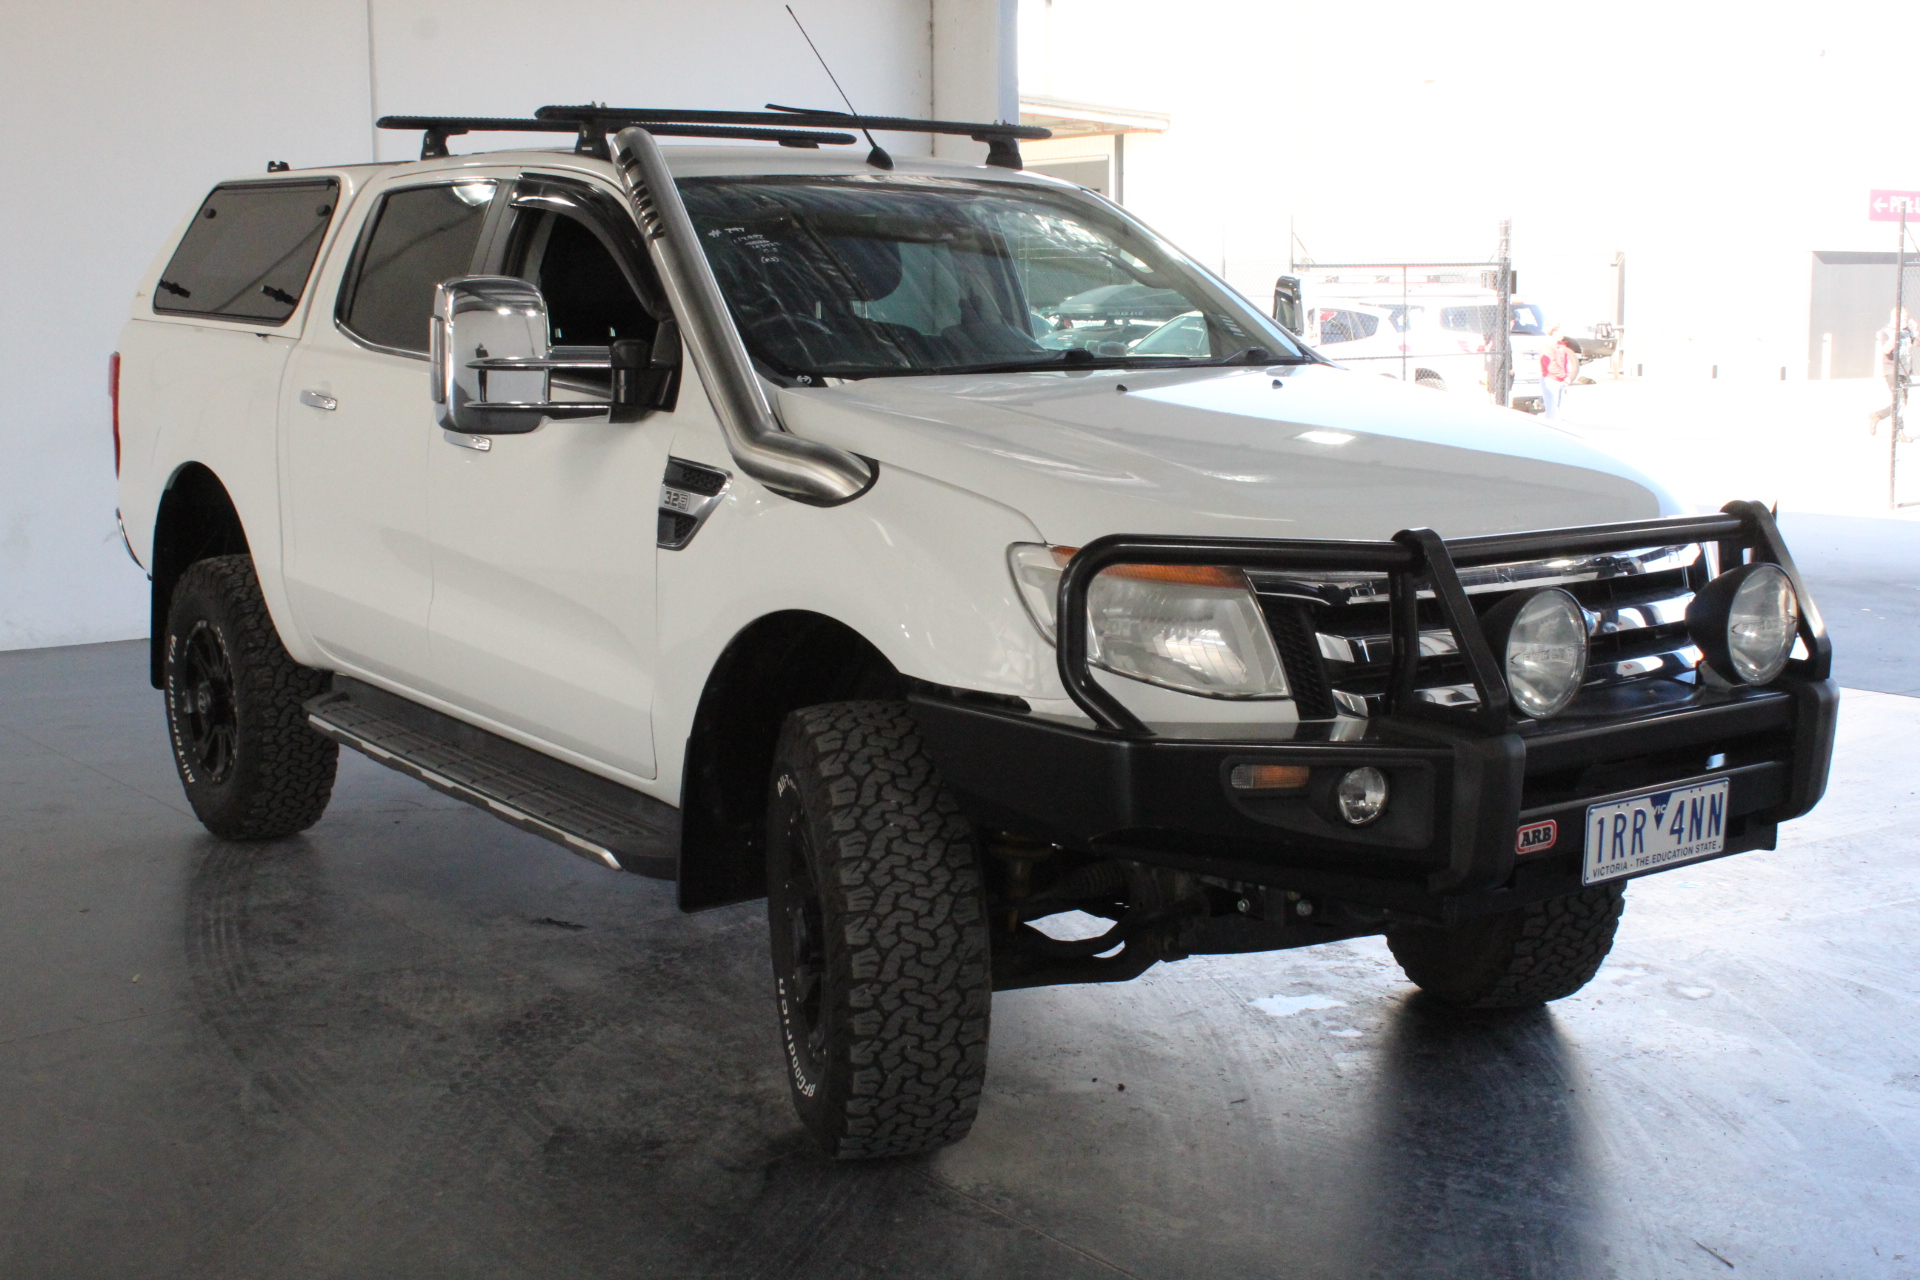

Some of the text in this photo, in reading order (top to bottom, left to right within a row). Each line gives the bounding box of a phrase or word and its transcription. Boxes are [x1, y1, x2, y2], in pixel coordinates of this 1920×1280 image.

[1520, 826, 1552, 848] ARB
[1597, 791, 1723, 864] 1RR 4NN
[1592, 861, 1628, 878] VICTORIA
[1636, 857, 1650, 868] THE
[1652, 846, 1693, 865] EDUCATION
[1695, 840, 1717, 854] STATE
[778, 977, 817, 1098] BFGoodrich
